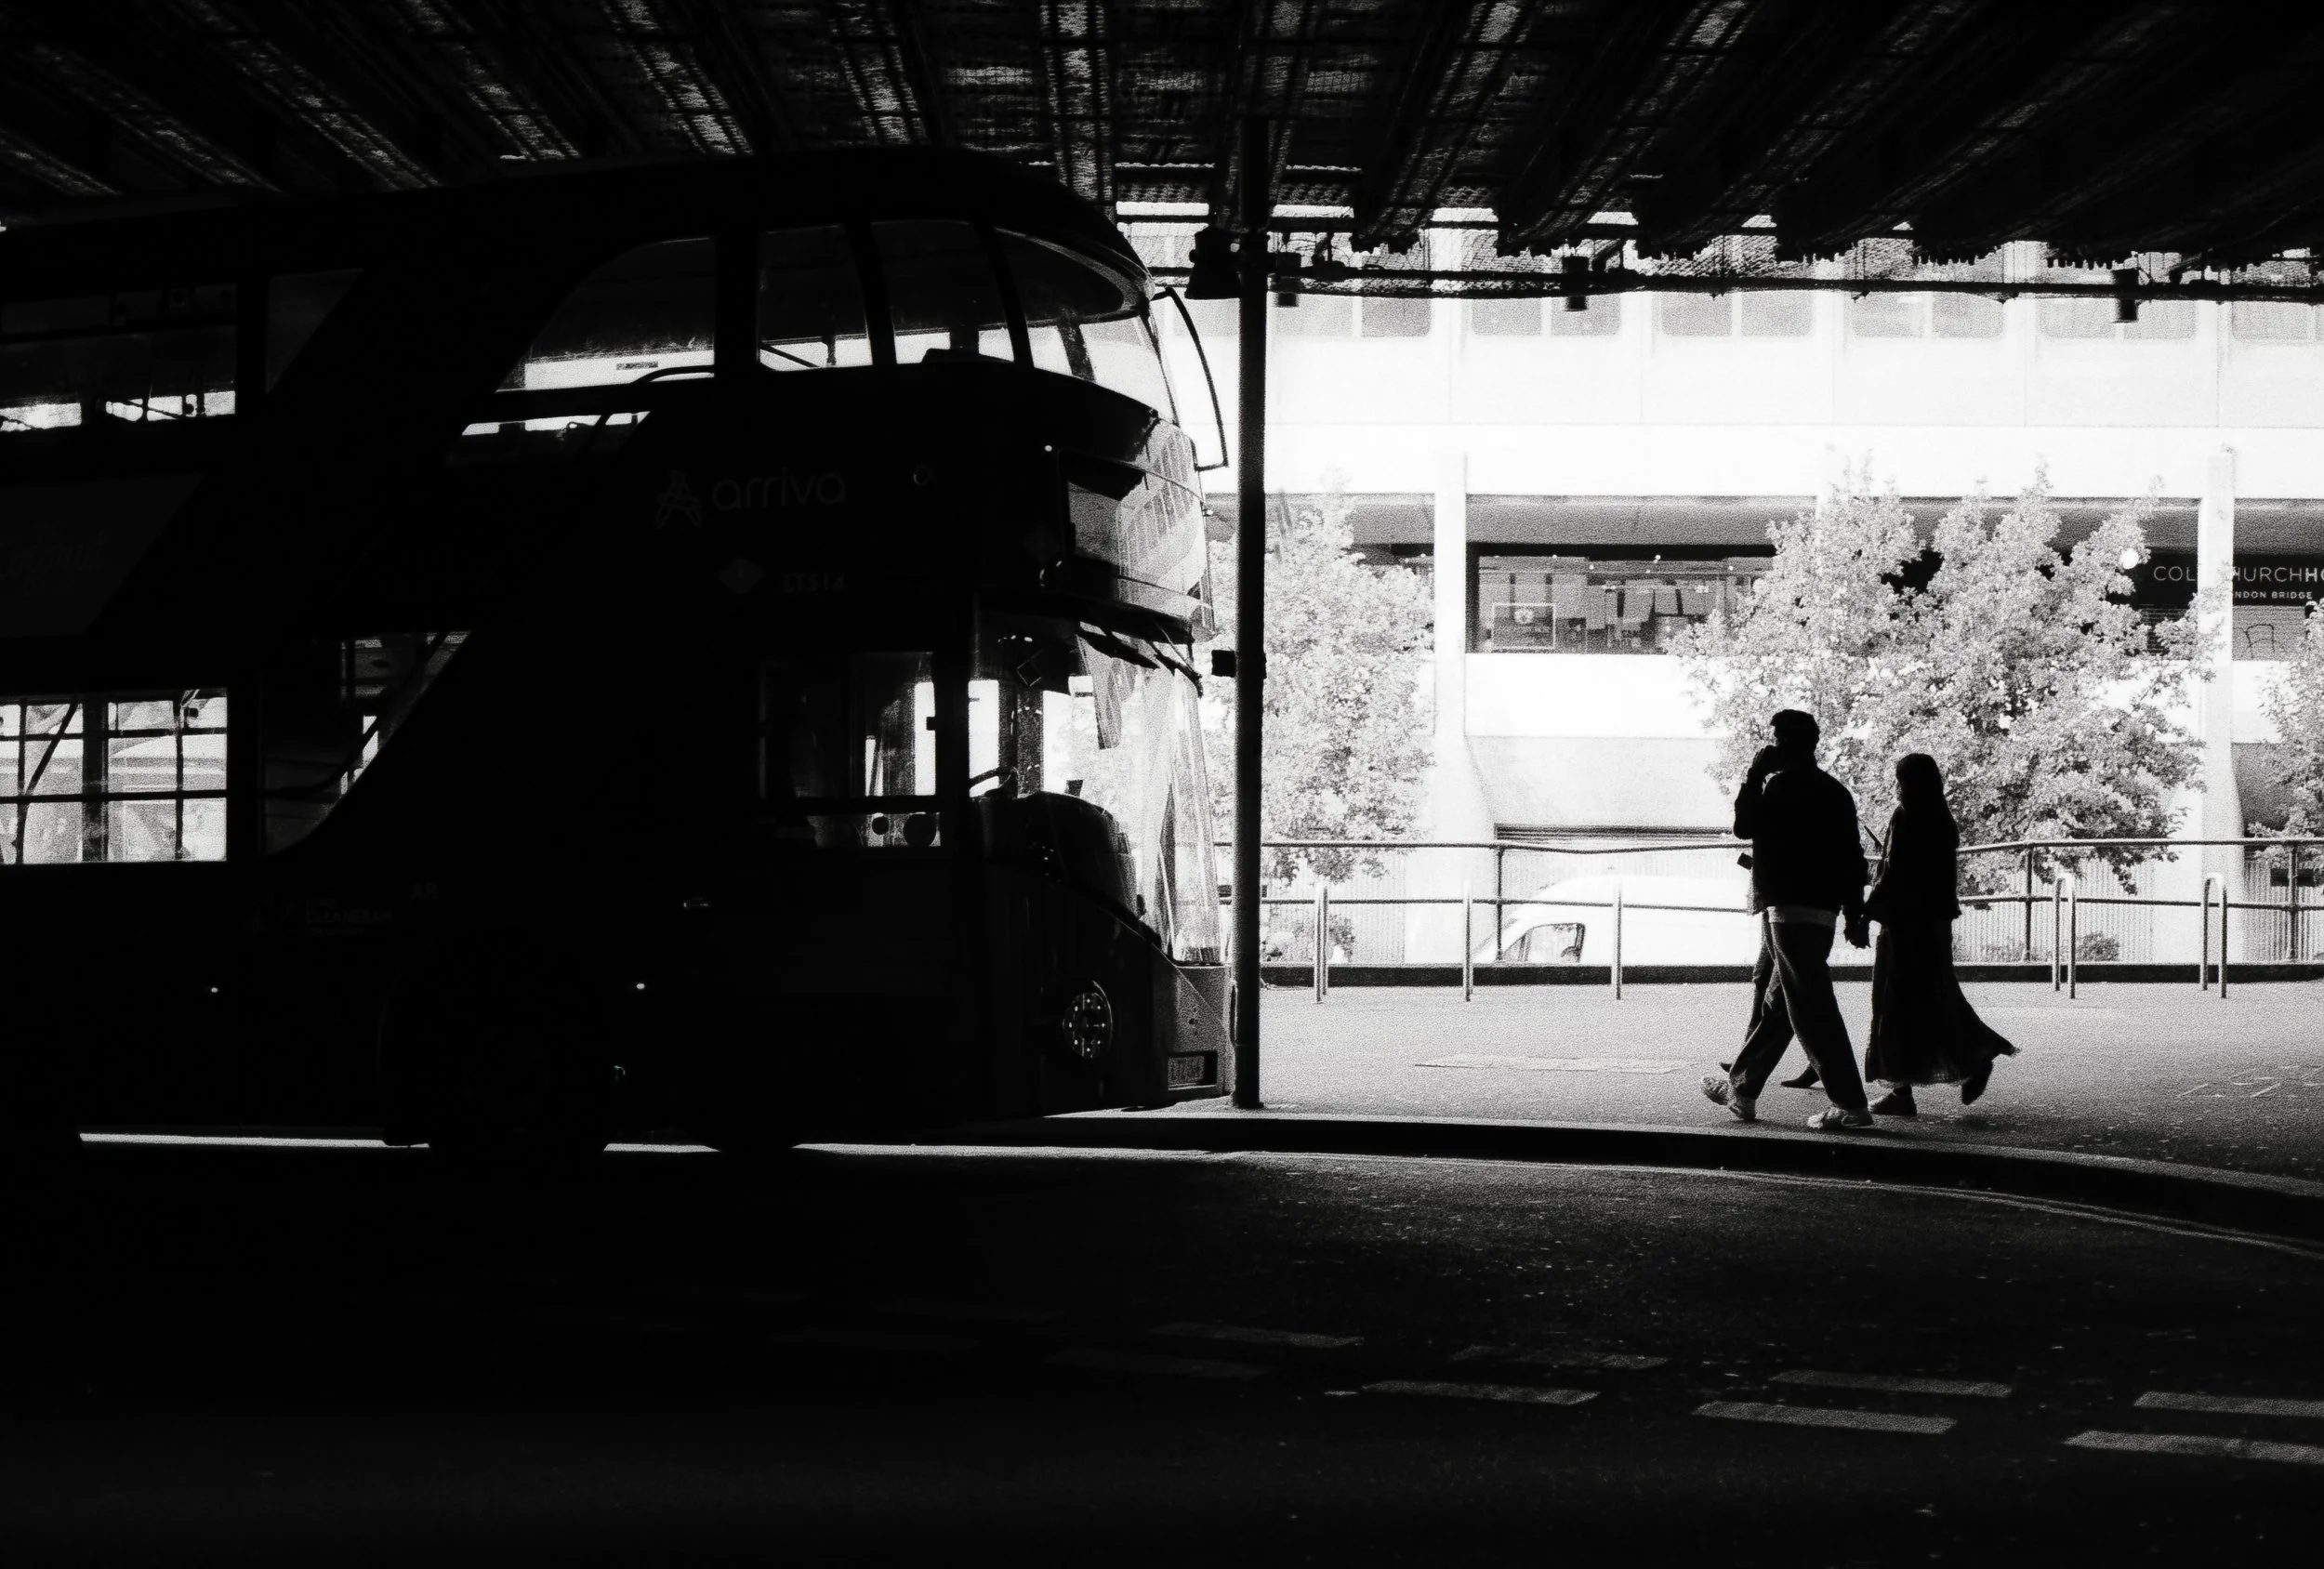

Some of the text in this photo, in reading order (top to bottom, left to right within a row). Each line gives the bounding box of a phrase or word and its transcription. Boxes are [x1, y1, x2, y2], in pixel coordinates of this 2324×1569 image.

[711, 466, 846, 511] arriva
[783, 571, 846, 593] LT514
[2234, 590, 2313, 600] NDON BRIDGE
